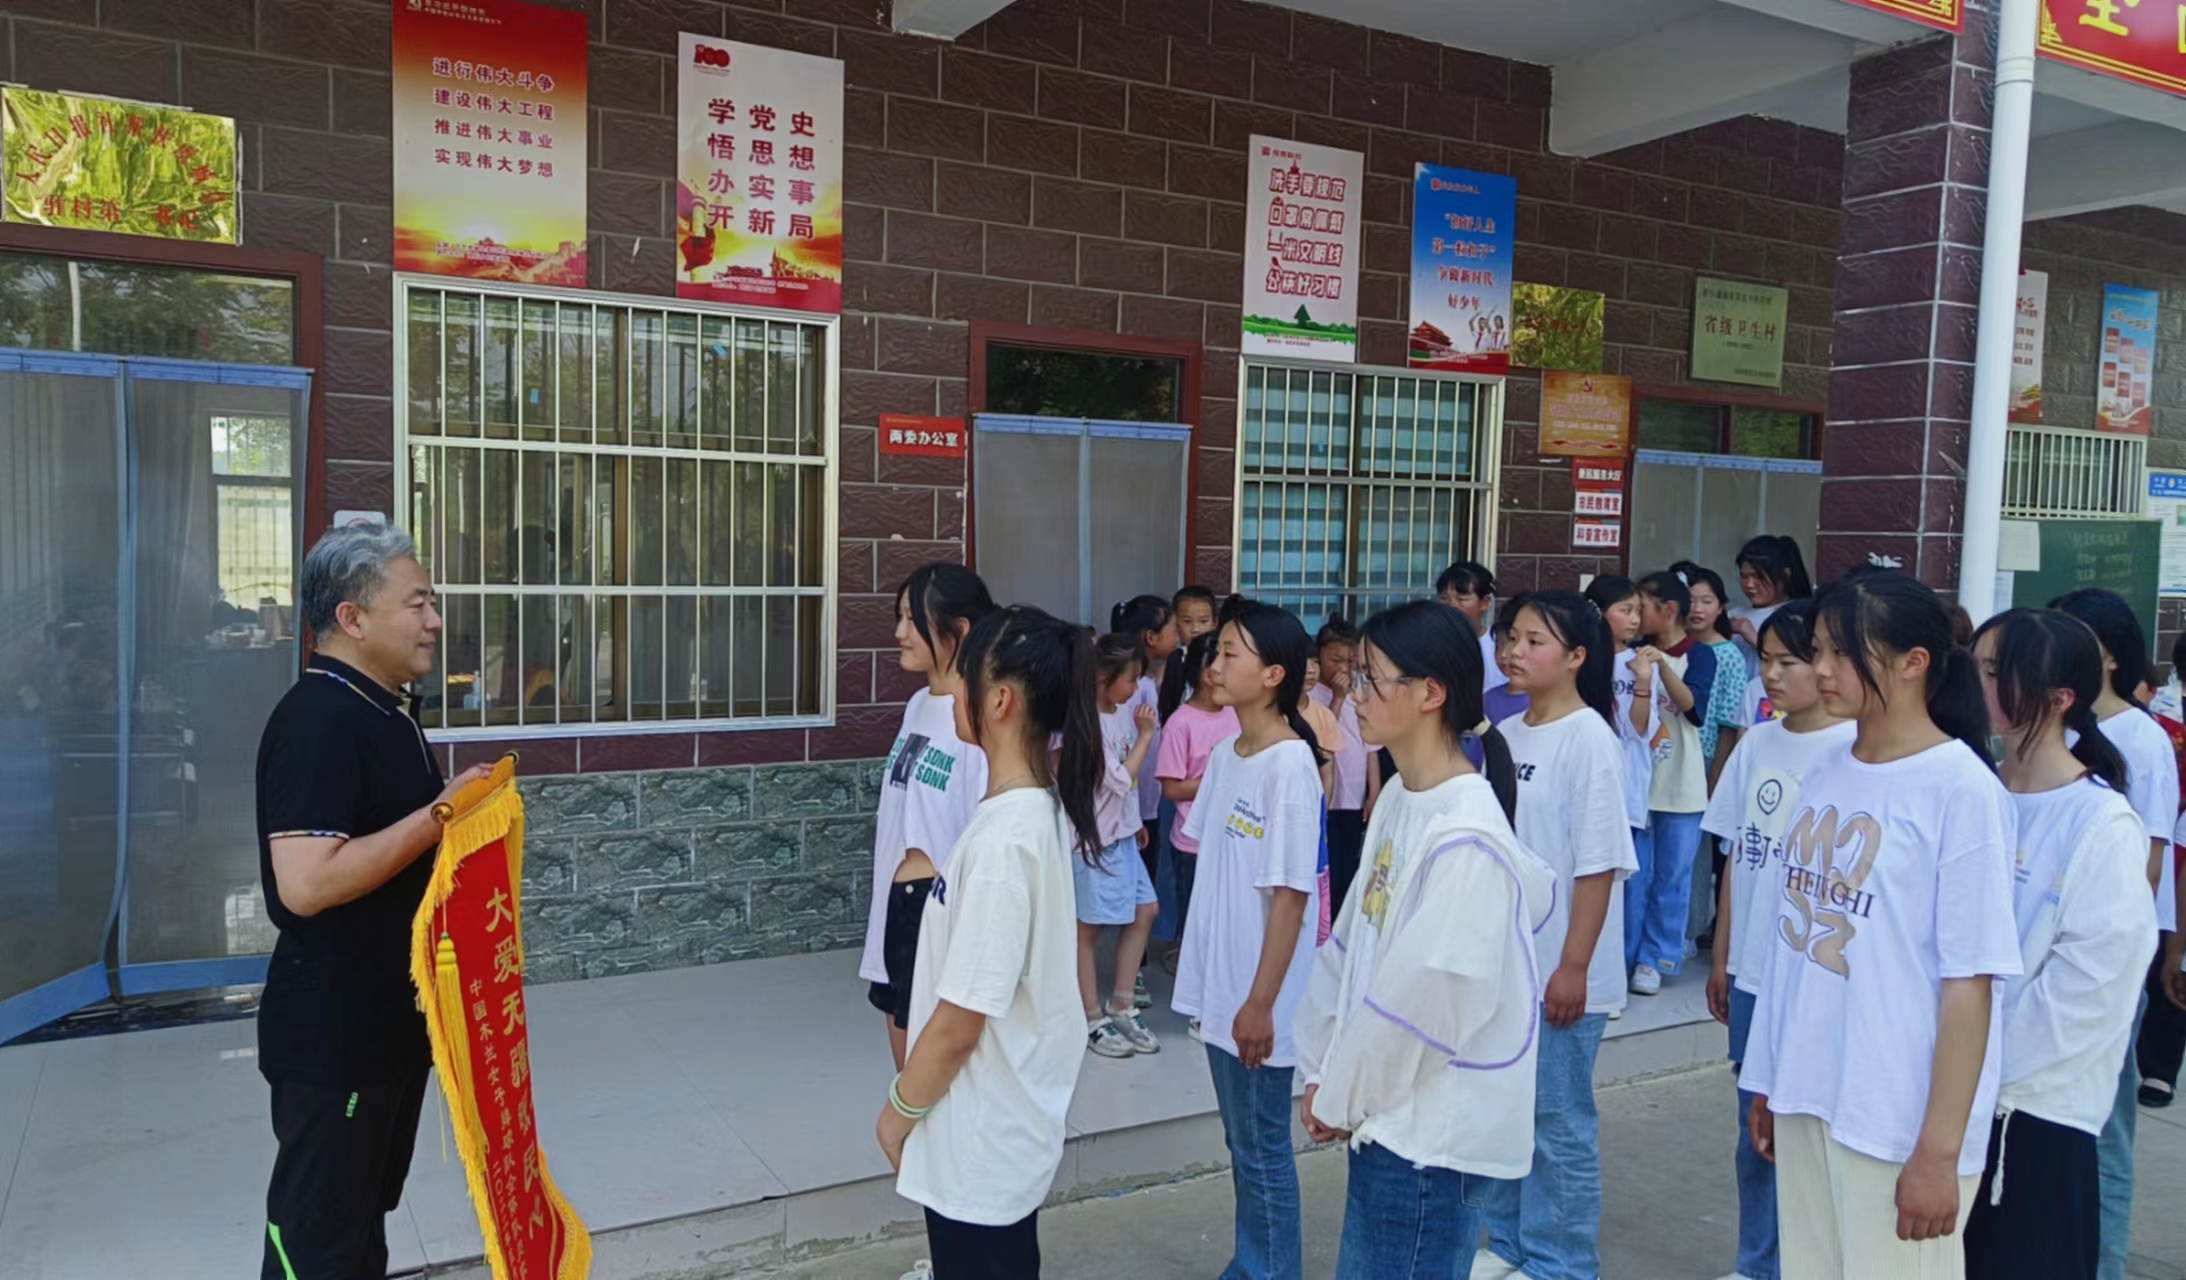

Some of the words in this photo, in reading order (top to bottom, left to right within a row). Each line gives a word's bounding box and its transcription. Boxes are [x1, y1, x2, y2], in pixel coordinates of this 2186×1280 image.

[433, 57, 556, 92] 进行伟大斗争
[434, 87, 554, 121] 建设伟大工程
[708, 98, 816, 138] 学党史
[434, 117, 554, 150] 推进伟大事业
[434, 147, 554, 178] 实现伟大梦想
[708, 132, 816, 172] 悟思想
[708, 168, 816, 206] 办实事
[1269, 167, 1346, 203] 洗手要规范
[708, 204, 815, 240] 开新局
[1267, 236, 1343, 268] 一米文明线
[1266, 264, 1342, 300] 公筷好习惯
[1447, 292, 1482, 312] 好少年
[1704, 313, 1777, 343] 省级卫生村
[889, 428, 959, 448] 两委办公室
[1514, 762, 1537, 783] CE
